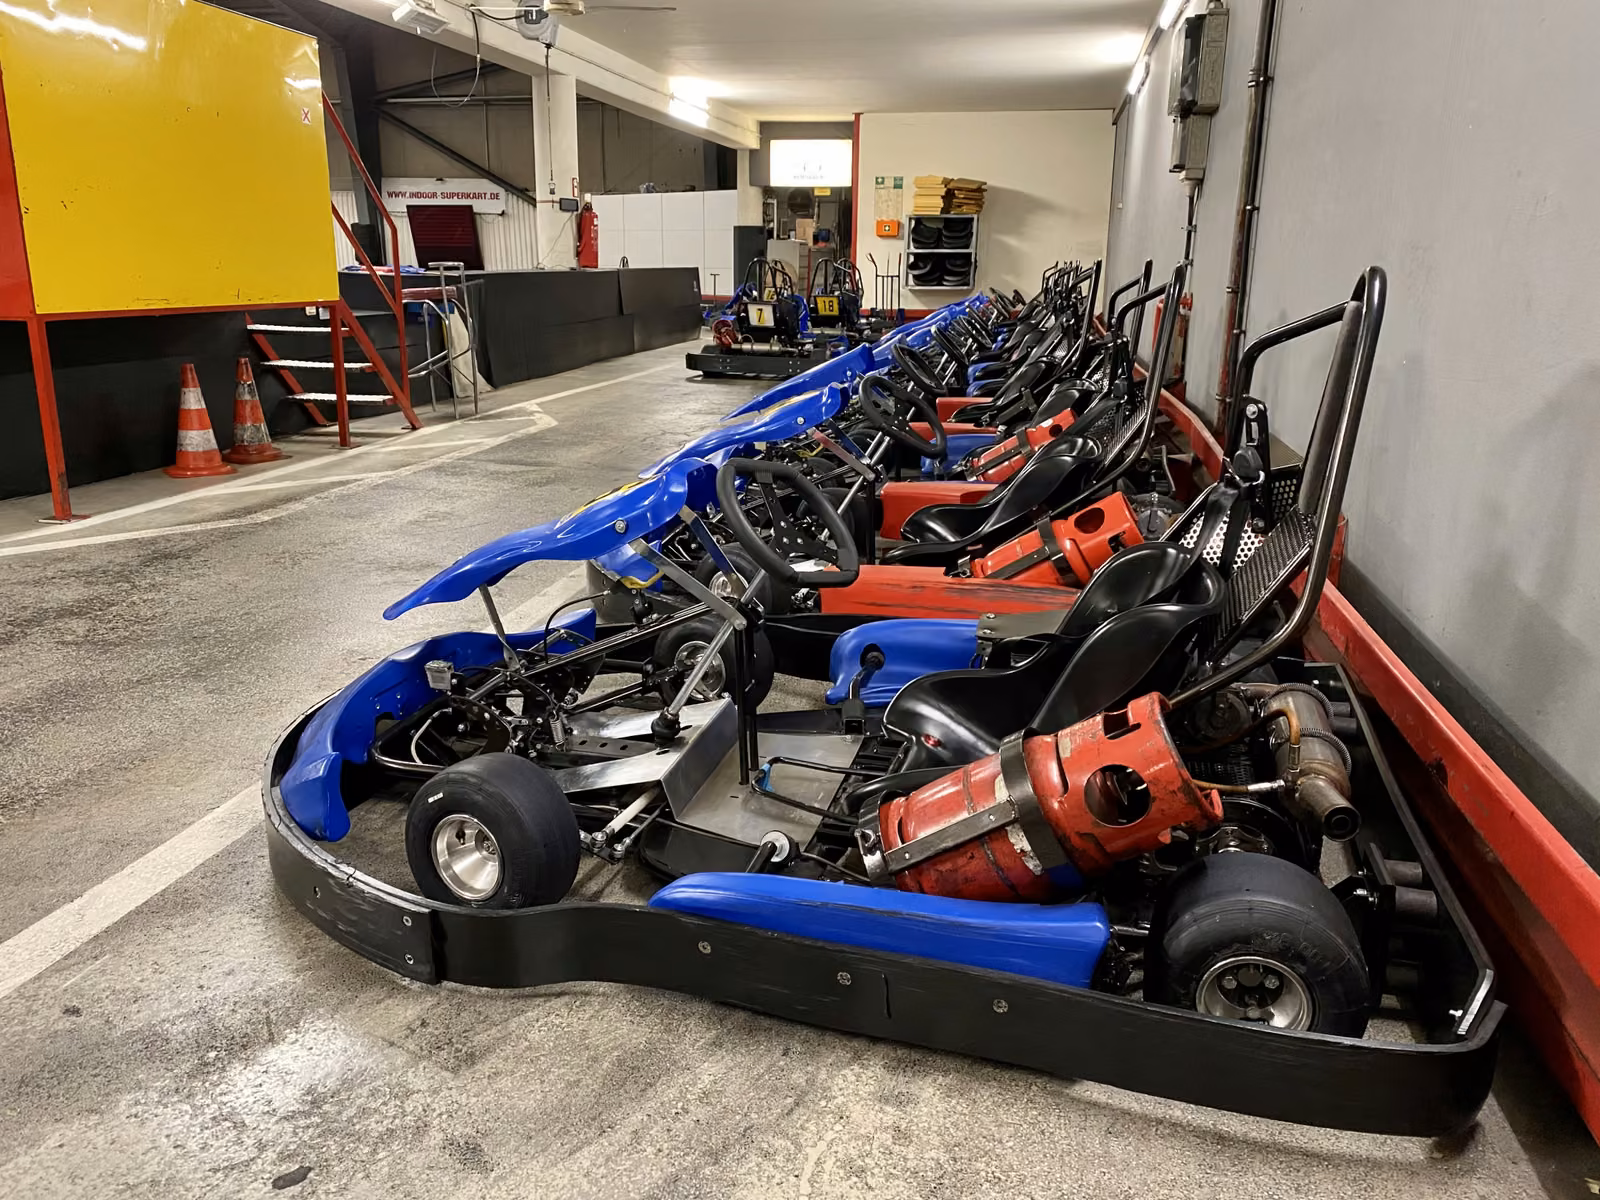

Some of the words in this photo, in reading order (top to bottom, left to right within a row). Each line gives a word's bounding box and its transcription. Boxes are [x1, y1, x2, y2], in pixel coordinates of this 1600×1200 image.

[386, 191, 501, 200] WWW.INDOOR-SUPERKART.DE
[823, 300, 834, 312] 18
[756, 307, 763, 323] 7
